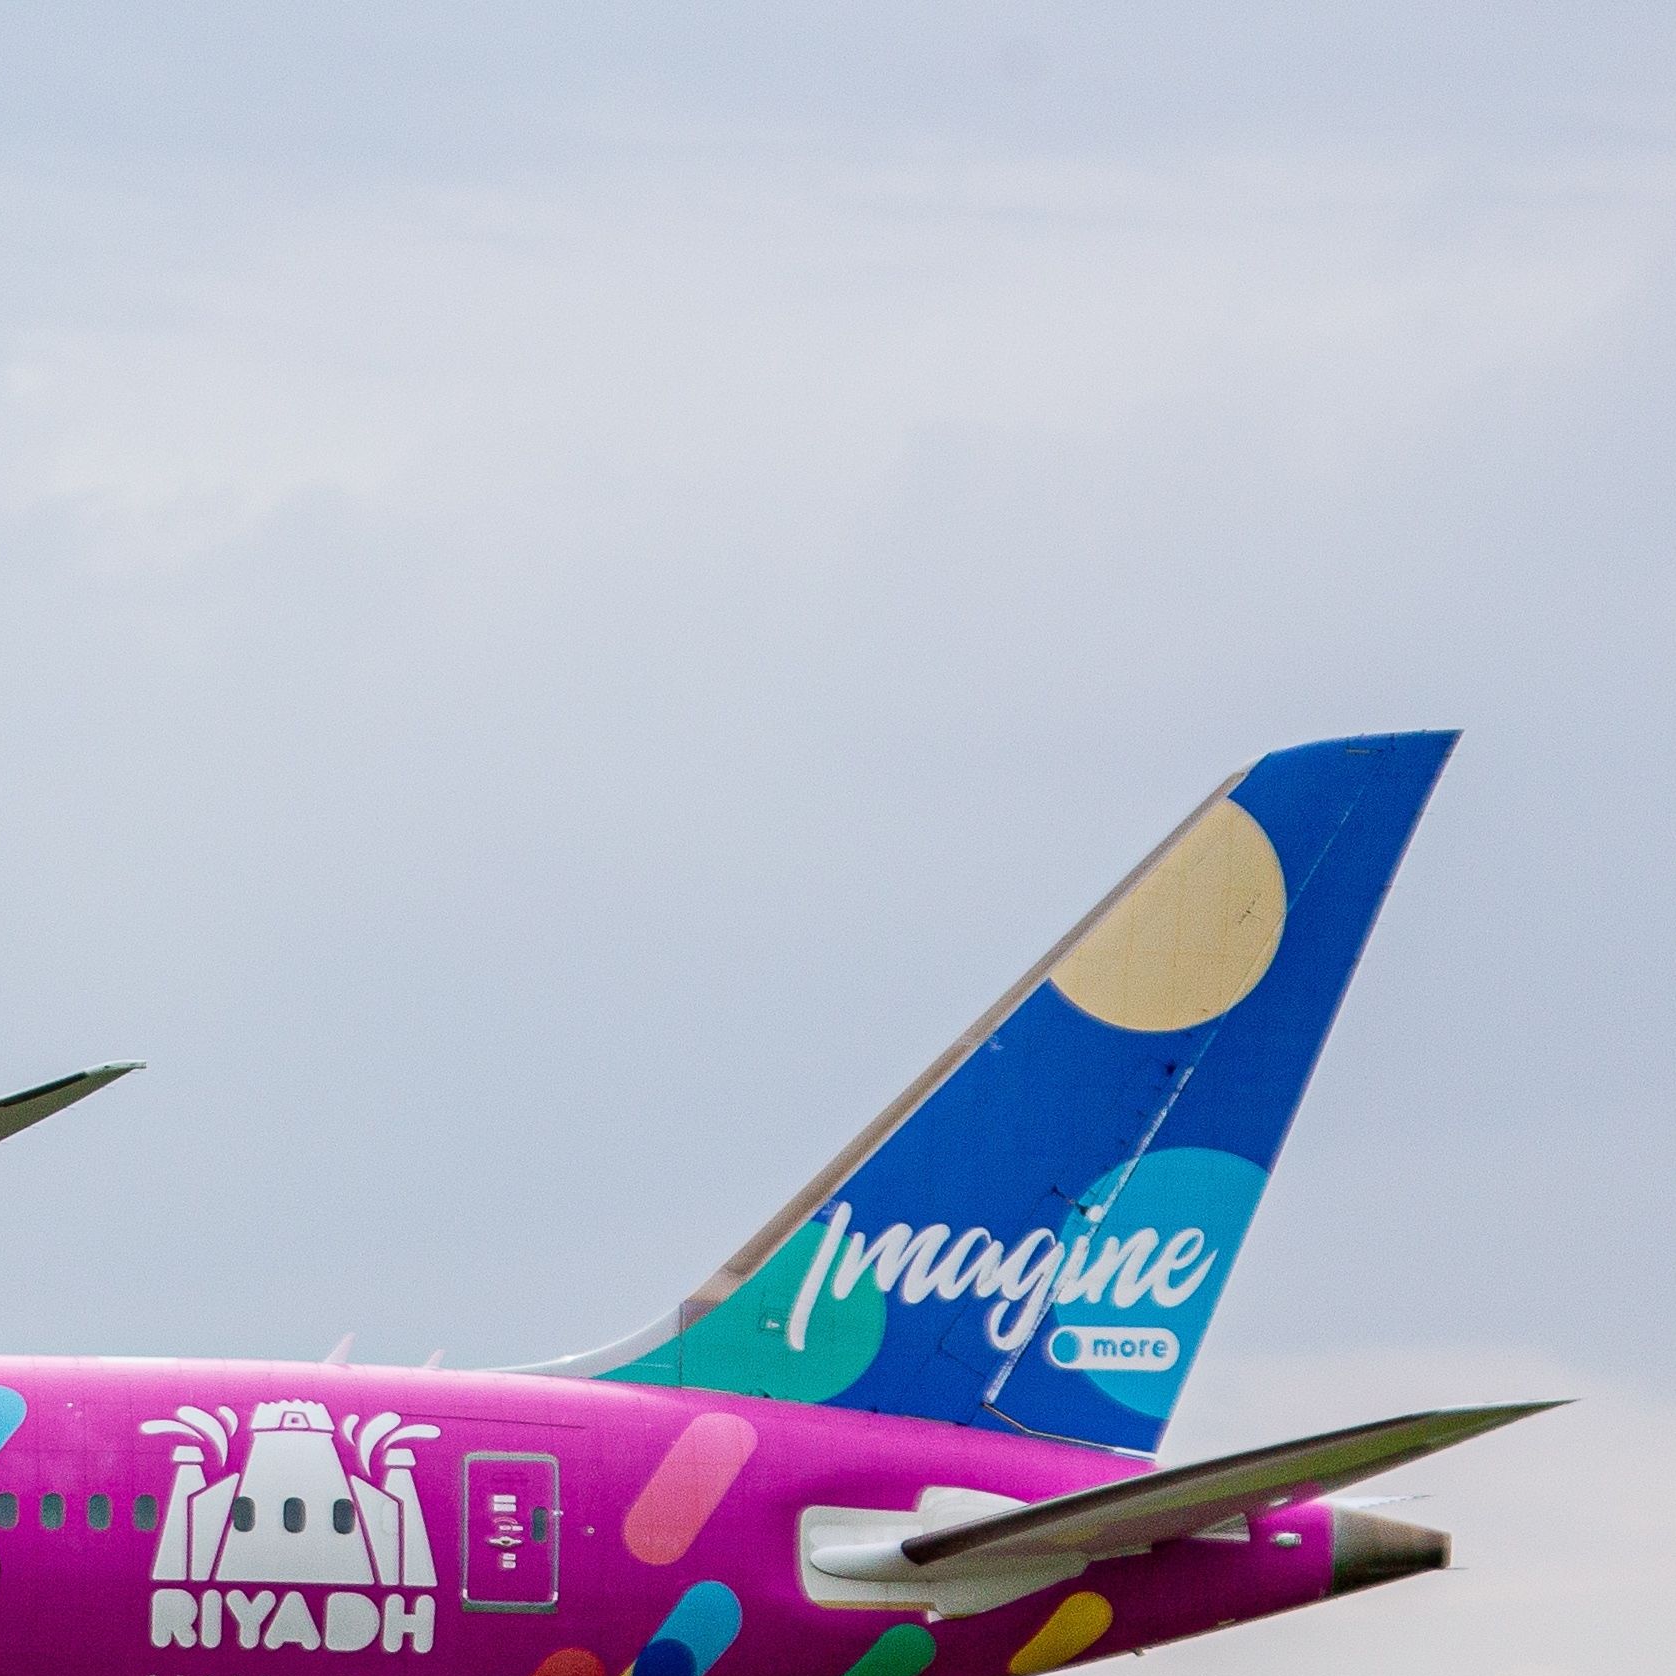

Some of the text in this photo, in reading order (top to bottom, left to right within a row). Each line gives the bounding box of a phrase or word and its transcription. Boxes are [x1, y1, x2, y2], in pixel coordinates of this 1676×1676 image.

[786, 1200, 1219, 1352] Imagine
[1092, 1335, 1169, 1358] more
[150, 1588, 436, 1653] RIYADH
